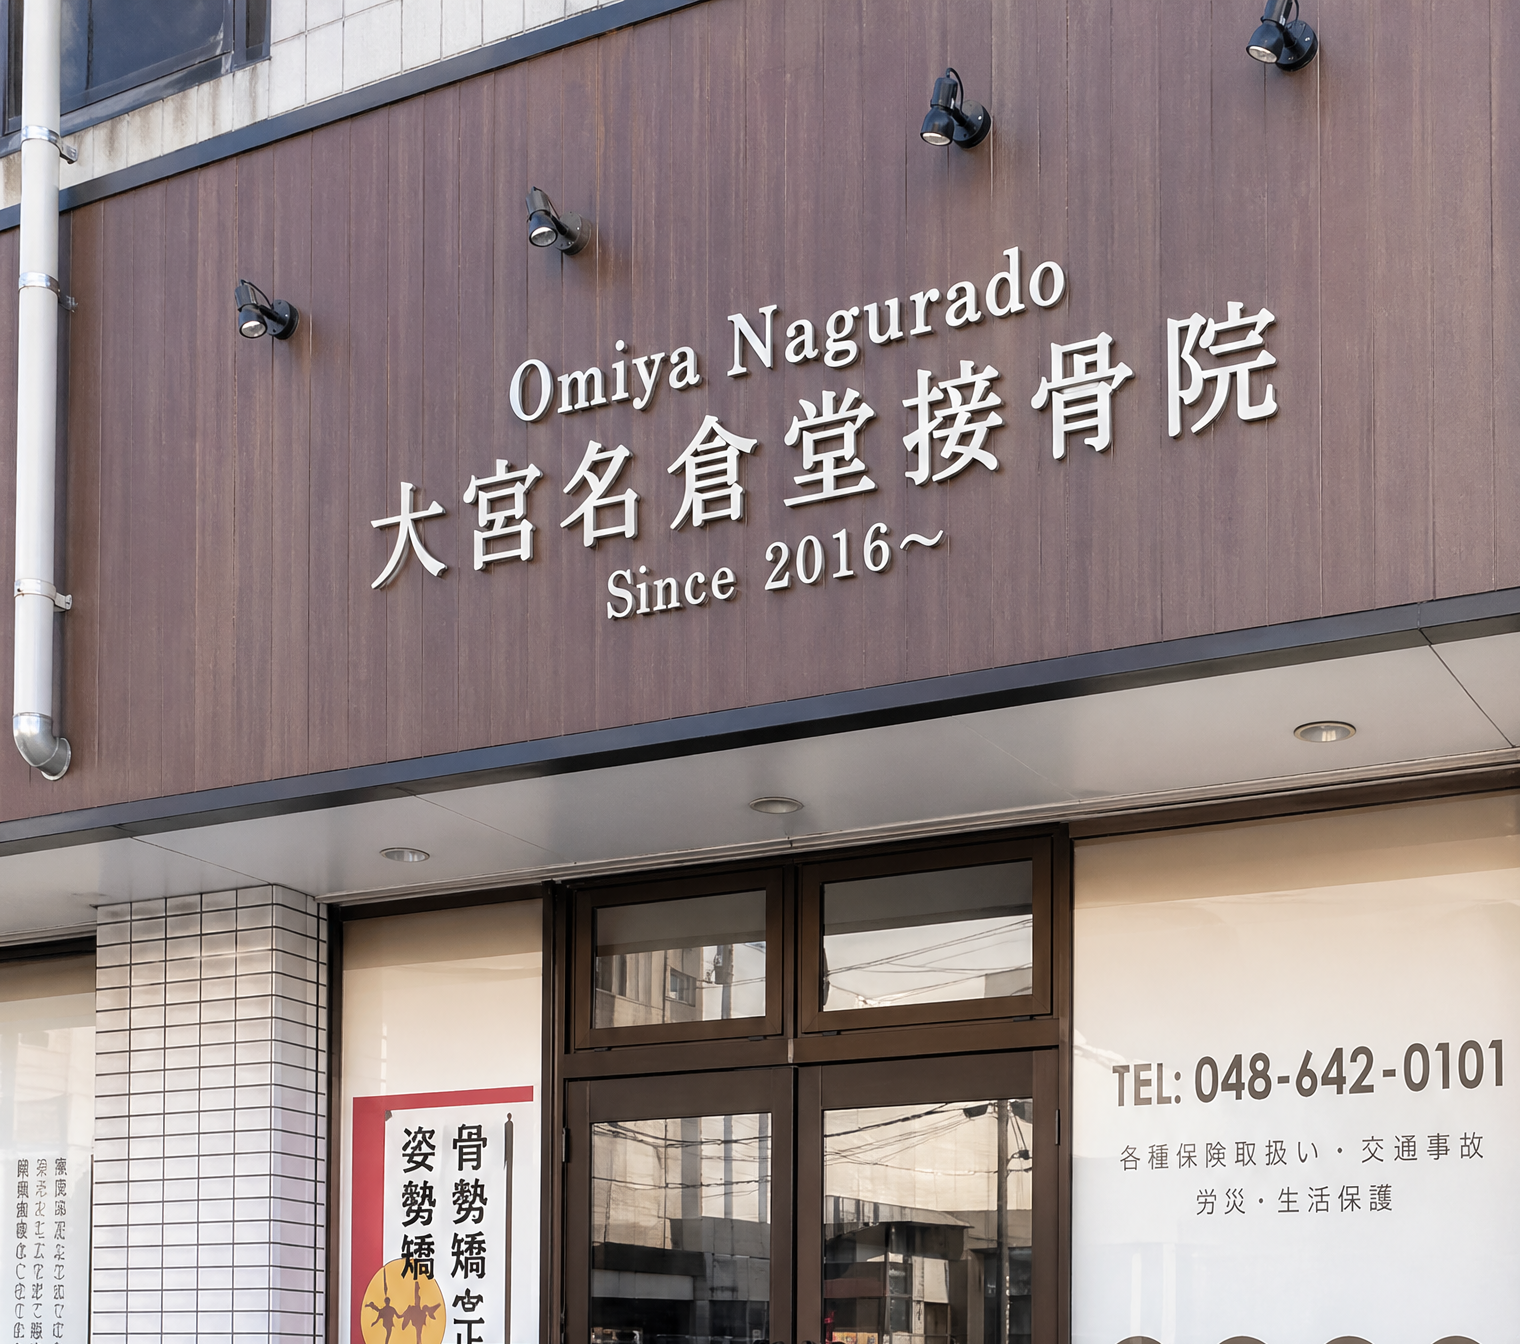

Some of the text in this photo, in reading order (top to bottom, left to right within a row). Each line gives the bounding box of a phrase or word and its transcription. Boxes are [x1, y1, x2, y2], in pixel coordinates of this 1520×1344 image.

[509, 246, 1065, 422] Omiya Nagurado
[370, 300, 1278, 589] 大宮名倉堂接骨院
[606, 566, 735, 619] Since
[1112, 1039, 1503, 1106] TEL: 048-642-0101
[1119, 1131, 1484, 1171] 各種保険取扱い・交通事故
[1196, 1183, 1393, 1216] 労災・生活保護
